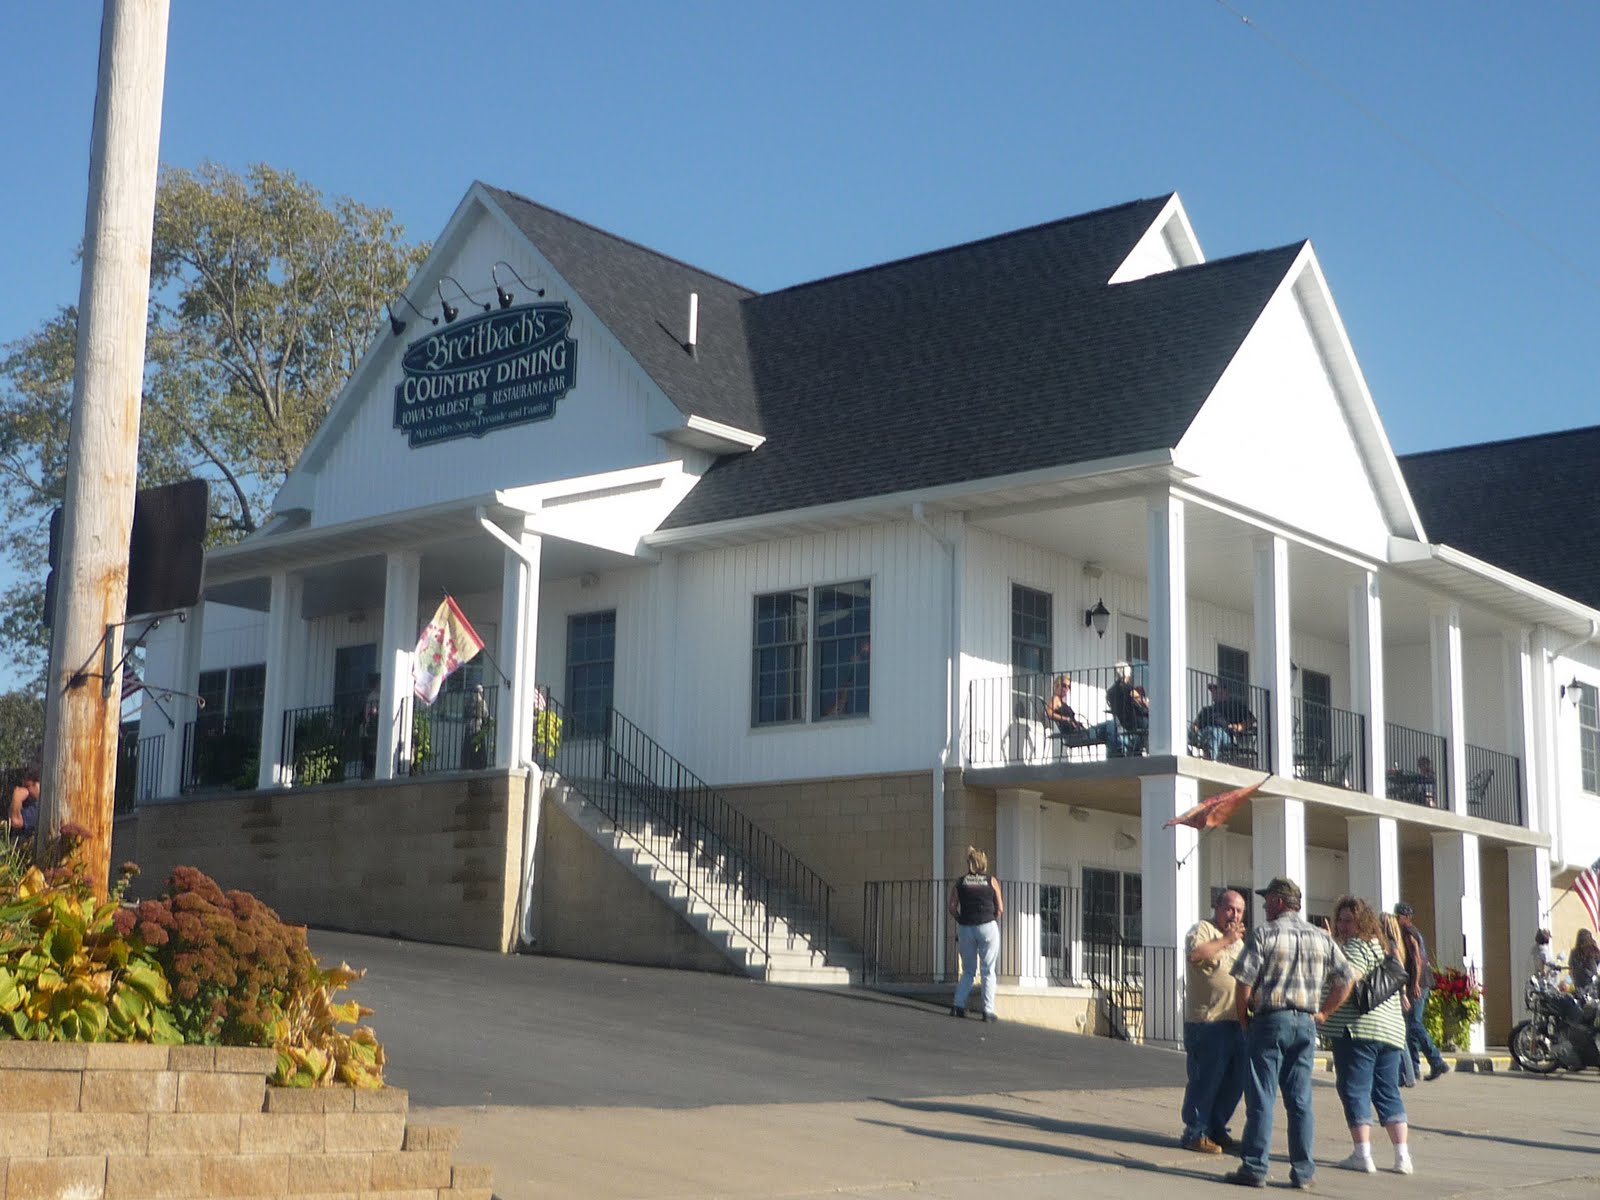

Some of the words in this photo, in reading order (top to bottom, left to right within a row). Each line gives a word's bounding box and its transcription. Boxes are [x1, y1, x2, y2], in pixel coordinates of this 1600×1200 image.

[426, 309, 546, 370] Breitbach's
[401, 405, 433, 426] IOWA'S
[435, 397, 471, 419] OLDEST
[492, 380, 542, 406] RESTAURANT
[548, 375, 566, 393] BAR
[404, 366, 492, 405] COUNTRY
[496, 340, 567, 384] DINING
